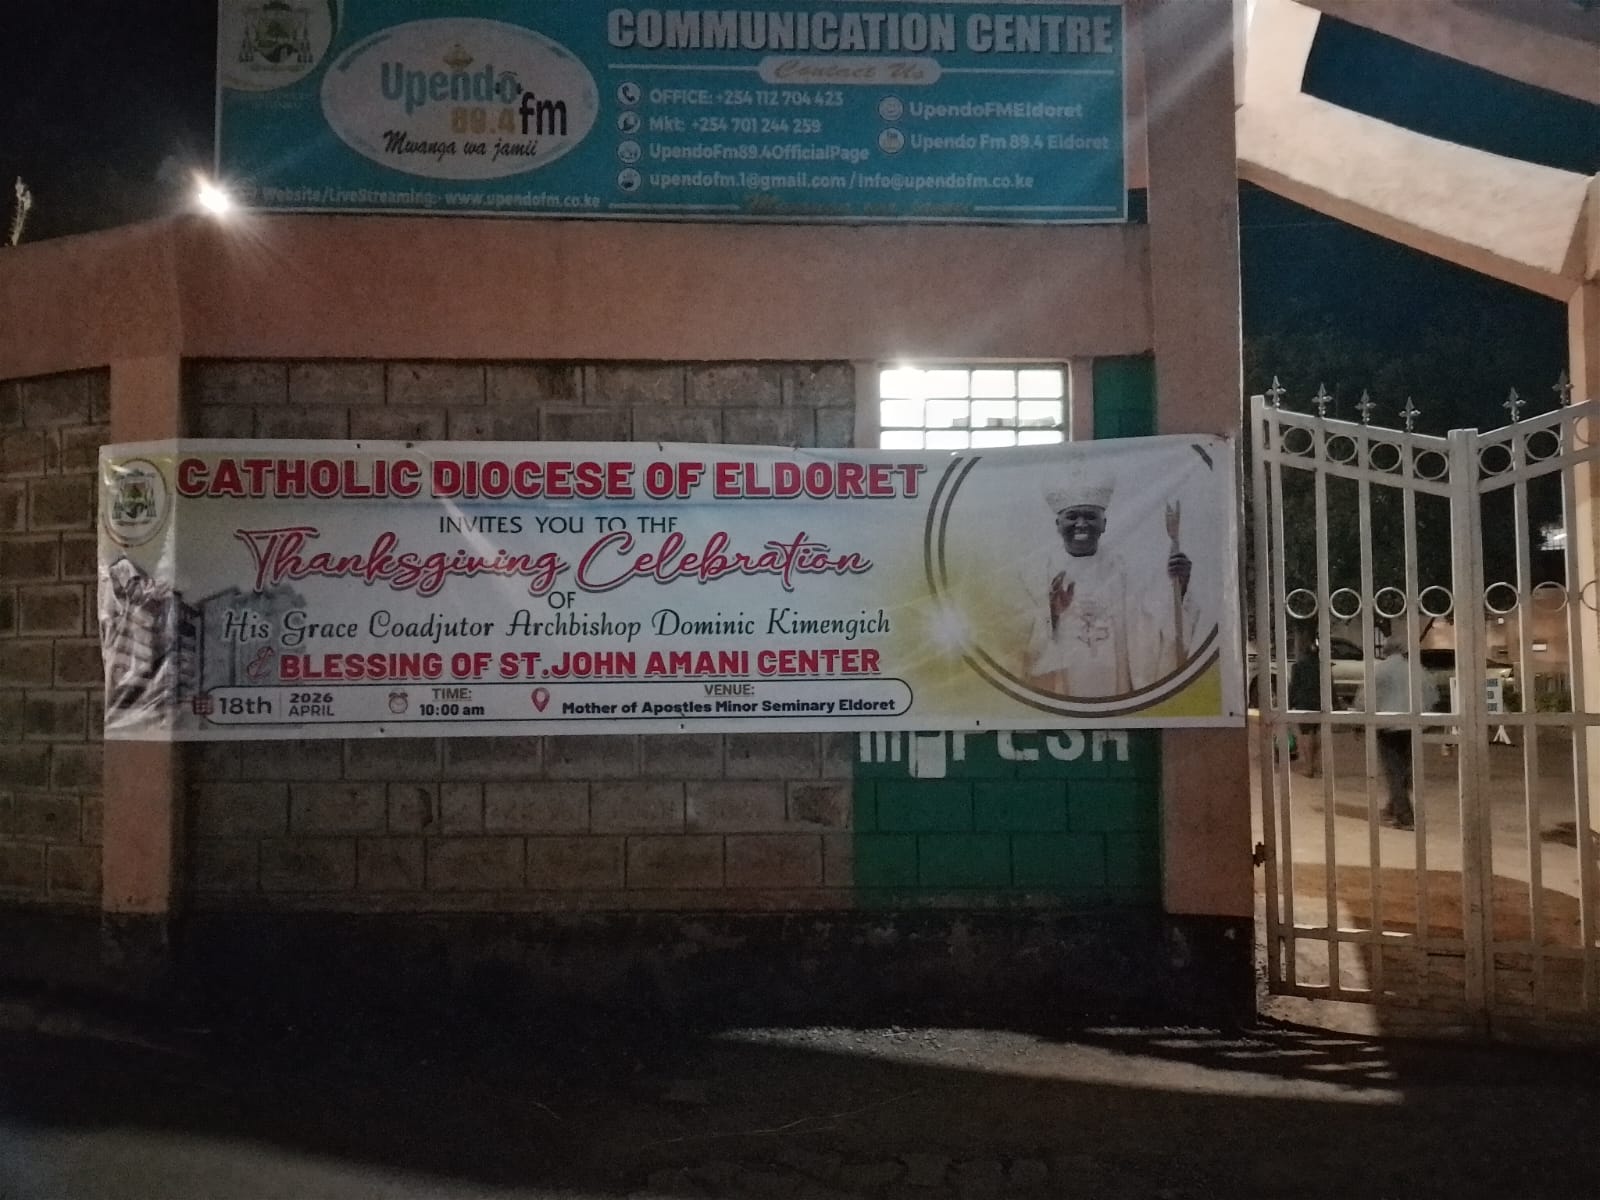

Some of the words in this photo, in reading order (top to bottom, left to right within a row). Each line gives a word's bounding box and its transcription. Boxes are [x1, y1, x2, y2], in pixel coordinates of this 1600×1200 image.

[608, 8, 955, 51] COMMUNICATION
[966, 13, 1113, 53] CENTRE
[774, 59, 876, 79] Contact
[381, 61, 520, 116] Upendo
[650, 90, 713, 105] OFFICE:
[716, 91, 753, 106] +254
[756, 91, 779, 106] 112
[782, 92, 811, 106] 704
[814, 92, 844, 106] 423
[451, 106, 515, 134] 89.4
[519, 91, 568, 136] fm
[909, 102, 1083, 120] UpendoFMEldoret
[650, 116, 686, 133] Mkt:
[692, 117, 728, 133] +254
[731, 117, 757, 133] 701
[761, 118, 789, 133] 244
[792, 118, 822, 134] 259
[383, 129, 456, 162] Mwanga
[464, 141, 486, 156] wa
[491, 138, 539, 162] jamii
[911, 133, 974, 151] Upendo
[980, 133, 1007, 150] Fm
[1009, 134, 1043, 150] 89.4
[1048, 134, 1110, 150] Eldoret
[650, 143, 870, 164] UpendoFm89.4OfficialPage
[445, 191, 601, 208] www.upendofm.co.ke
[177, 458, 422, 498] CATHOLIC
[432, 460, 635, 498] DIOCESE
[645, 460, 706, 498] OF
[714, 461, 926, 498] ELDORET
[440, 516, 522, 533] INVITES
[536, 517, 583, 533] YOU
[595, 517, 626, 533] TO
[234, 526, 569, 597] Thanksgiving
[575, 530, 872, 593] Celebration
[547, 591, 577, 609] OF
[224, 611, 269, 642] His
[281, 610, 358, 646] Grace
[369, 611, 494, 644] Coadjutor
[505, 609, 641, 643] Archbishop
[651, 608, 755, 637] Dominic
[767, 608, 891, 641] Kimengich
[279, 652, 443, 681] BLESSING
[451, 653, 493, 679] OF
[500, 652, 636, 678] ST.JOHN
[645, 650, 750, 677] AMANI
[757, 648, 881, 676] CENTER
[289, 692, 333, 704] 2026
[432, 687, 472, 700] TIME:
[704, 684, 755, 697] VENUE:
[218, 697, 272, 715] 18th
[288, 705, 335, 717] APRIL
[419, 703, 459, 717] 10:00
[463, 705, 485, 716] am
[562, 701, 617, 715] Mother
[620, 701, 638, 714] of
[642, 701, 712, 717] Apostles
[716, 700, 757, 714] Minor
[762, 699, 835, 716] Seminary
[839, 698, 895, 712] Eldoret
